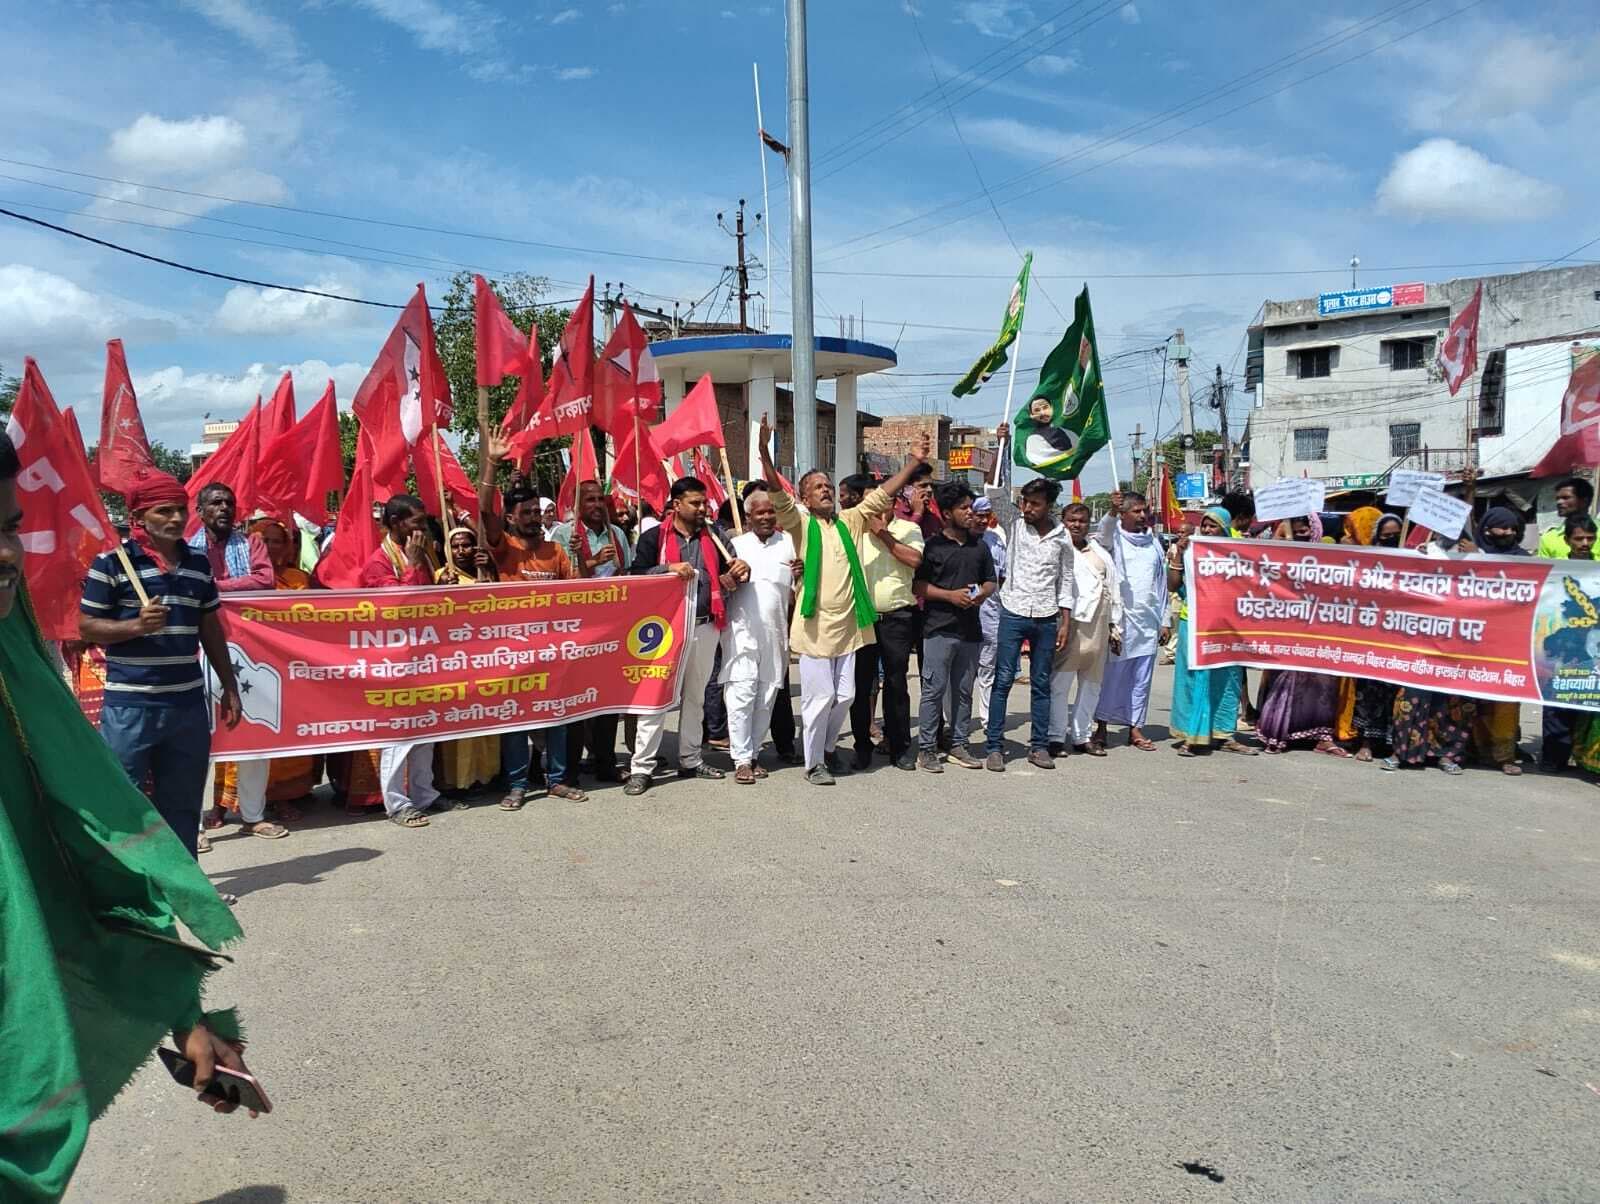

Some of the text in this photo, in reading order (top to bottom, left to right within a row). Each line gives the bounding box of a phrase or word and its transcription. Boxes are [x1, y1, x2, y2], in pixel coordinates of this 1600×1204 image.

[1197, 550, 1255, 580] केन्द्रीय
[1258, 554, 1283, 586] ट्रेड
[1287, 555, 1360, 589] यूनियनों
[1359, 561, 1396, 590] और
[1397, 566, 1453, 595] स्वतंत्र
[555, 584, 628, 608] बचाओ!
[349, 625, 440, 649] INDIA
[448, 623, 474, 642] के
[552, 618, 582, 634] पर
[1359, 601, 1380, 627] के
[1382, 609, 1456, 638] आहवान
[1459, 618, 1487, 642] पर
[638, 621, 666, 655] 9
[288, 660, 347, 681] बिहार
[347, 655, 368, 680] में
[370, 654, 438, 678] वोटबंदी
[441, 650, 467, 671] की
[538, 645, 559, 663] के
[621, 661, 673, 684] जुलाई
[364, 672, 550, 707] चक्का जाम
[532, 687, 598, 717] मधुबनी
